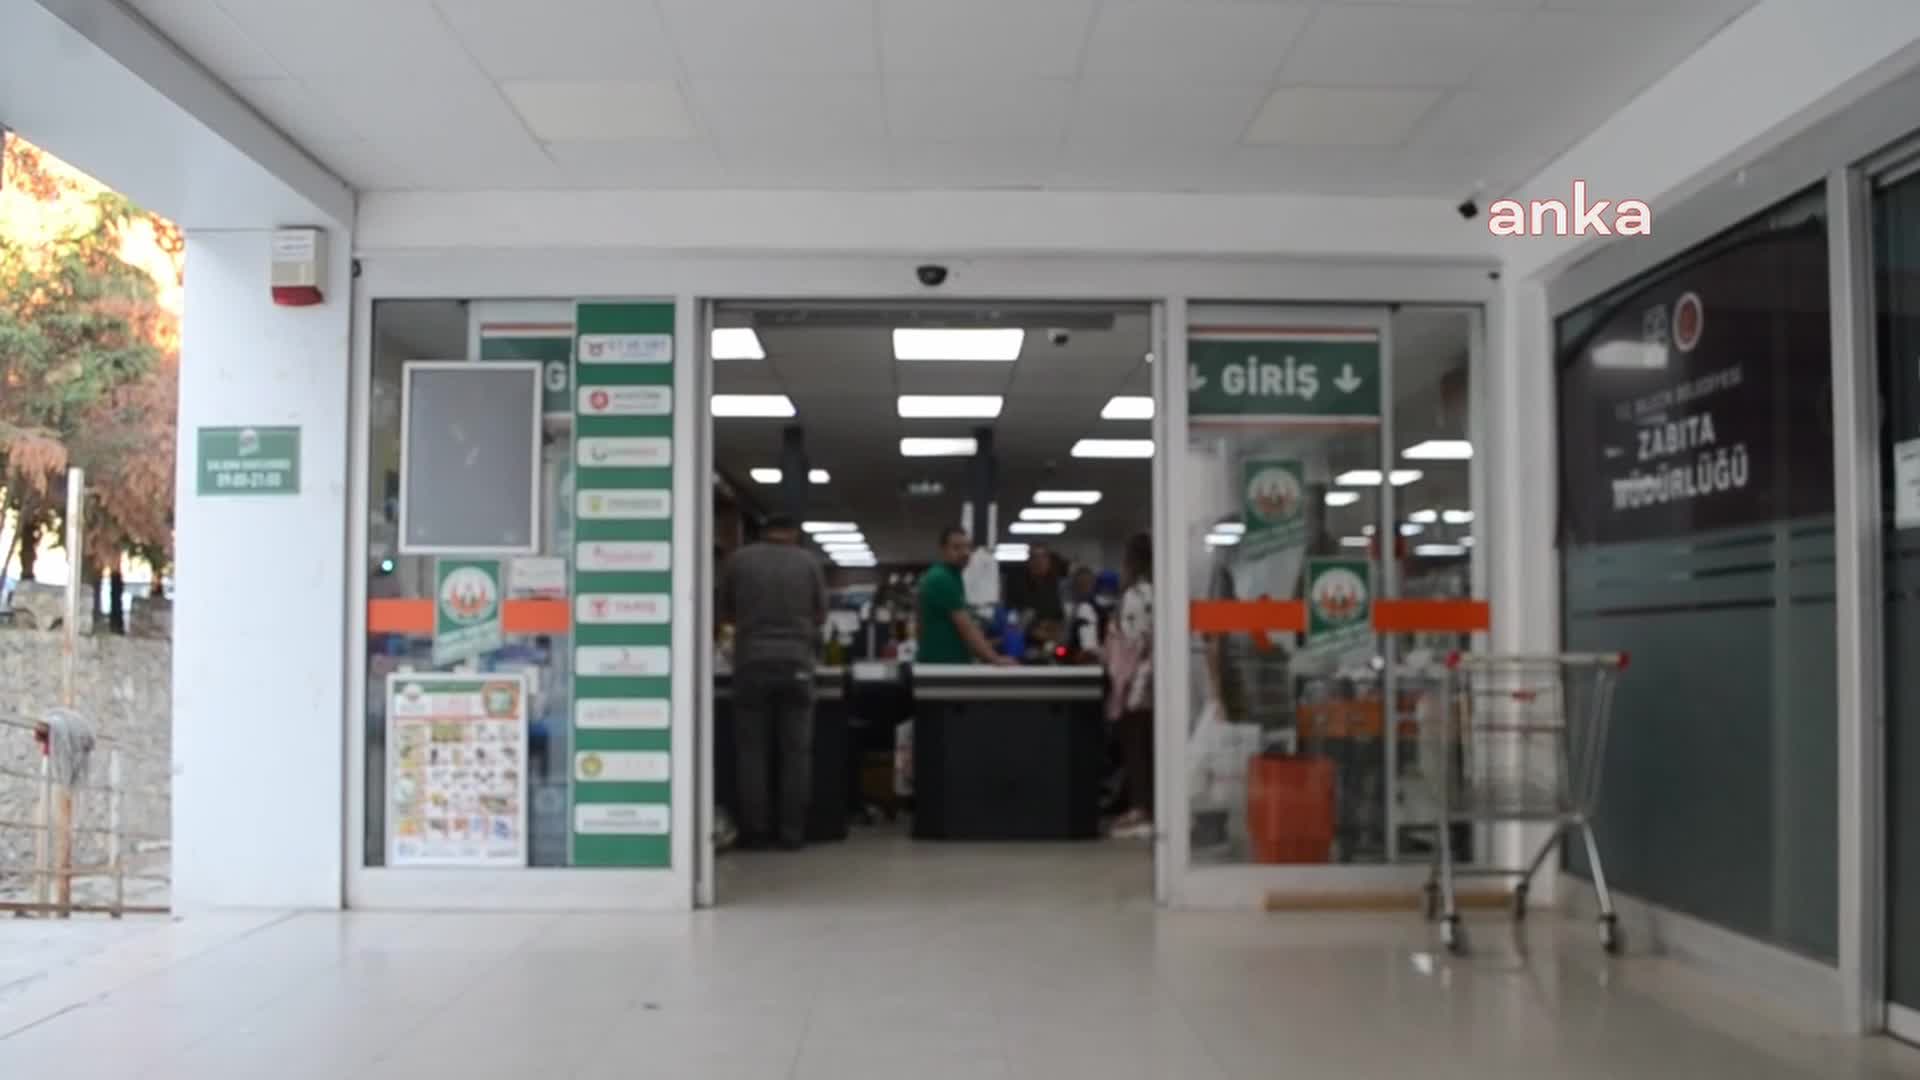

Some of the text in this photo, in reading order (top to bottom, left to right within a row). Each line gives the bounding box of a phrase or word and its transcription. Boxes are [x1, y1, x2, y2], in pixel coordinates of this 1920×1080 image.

[1221, 355, 1320, 401] GİRİŞ
[1637, 412, 1715, 462] ZABITA
[1612, 443, 1749, 512] MÜDÜRLÜĞÜ
